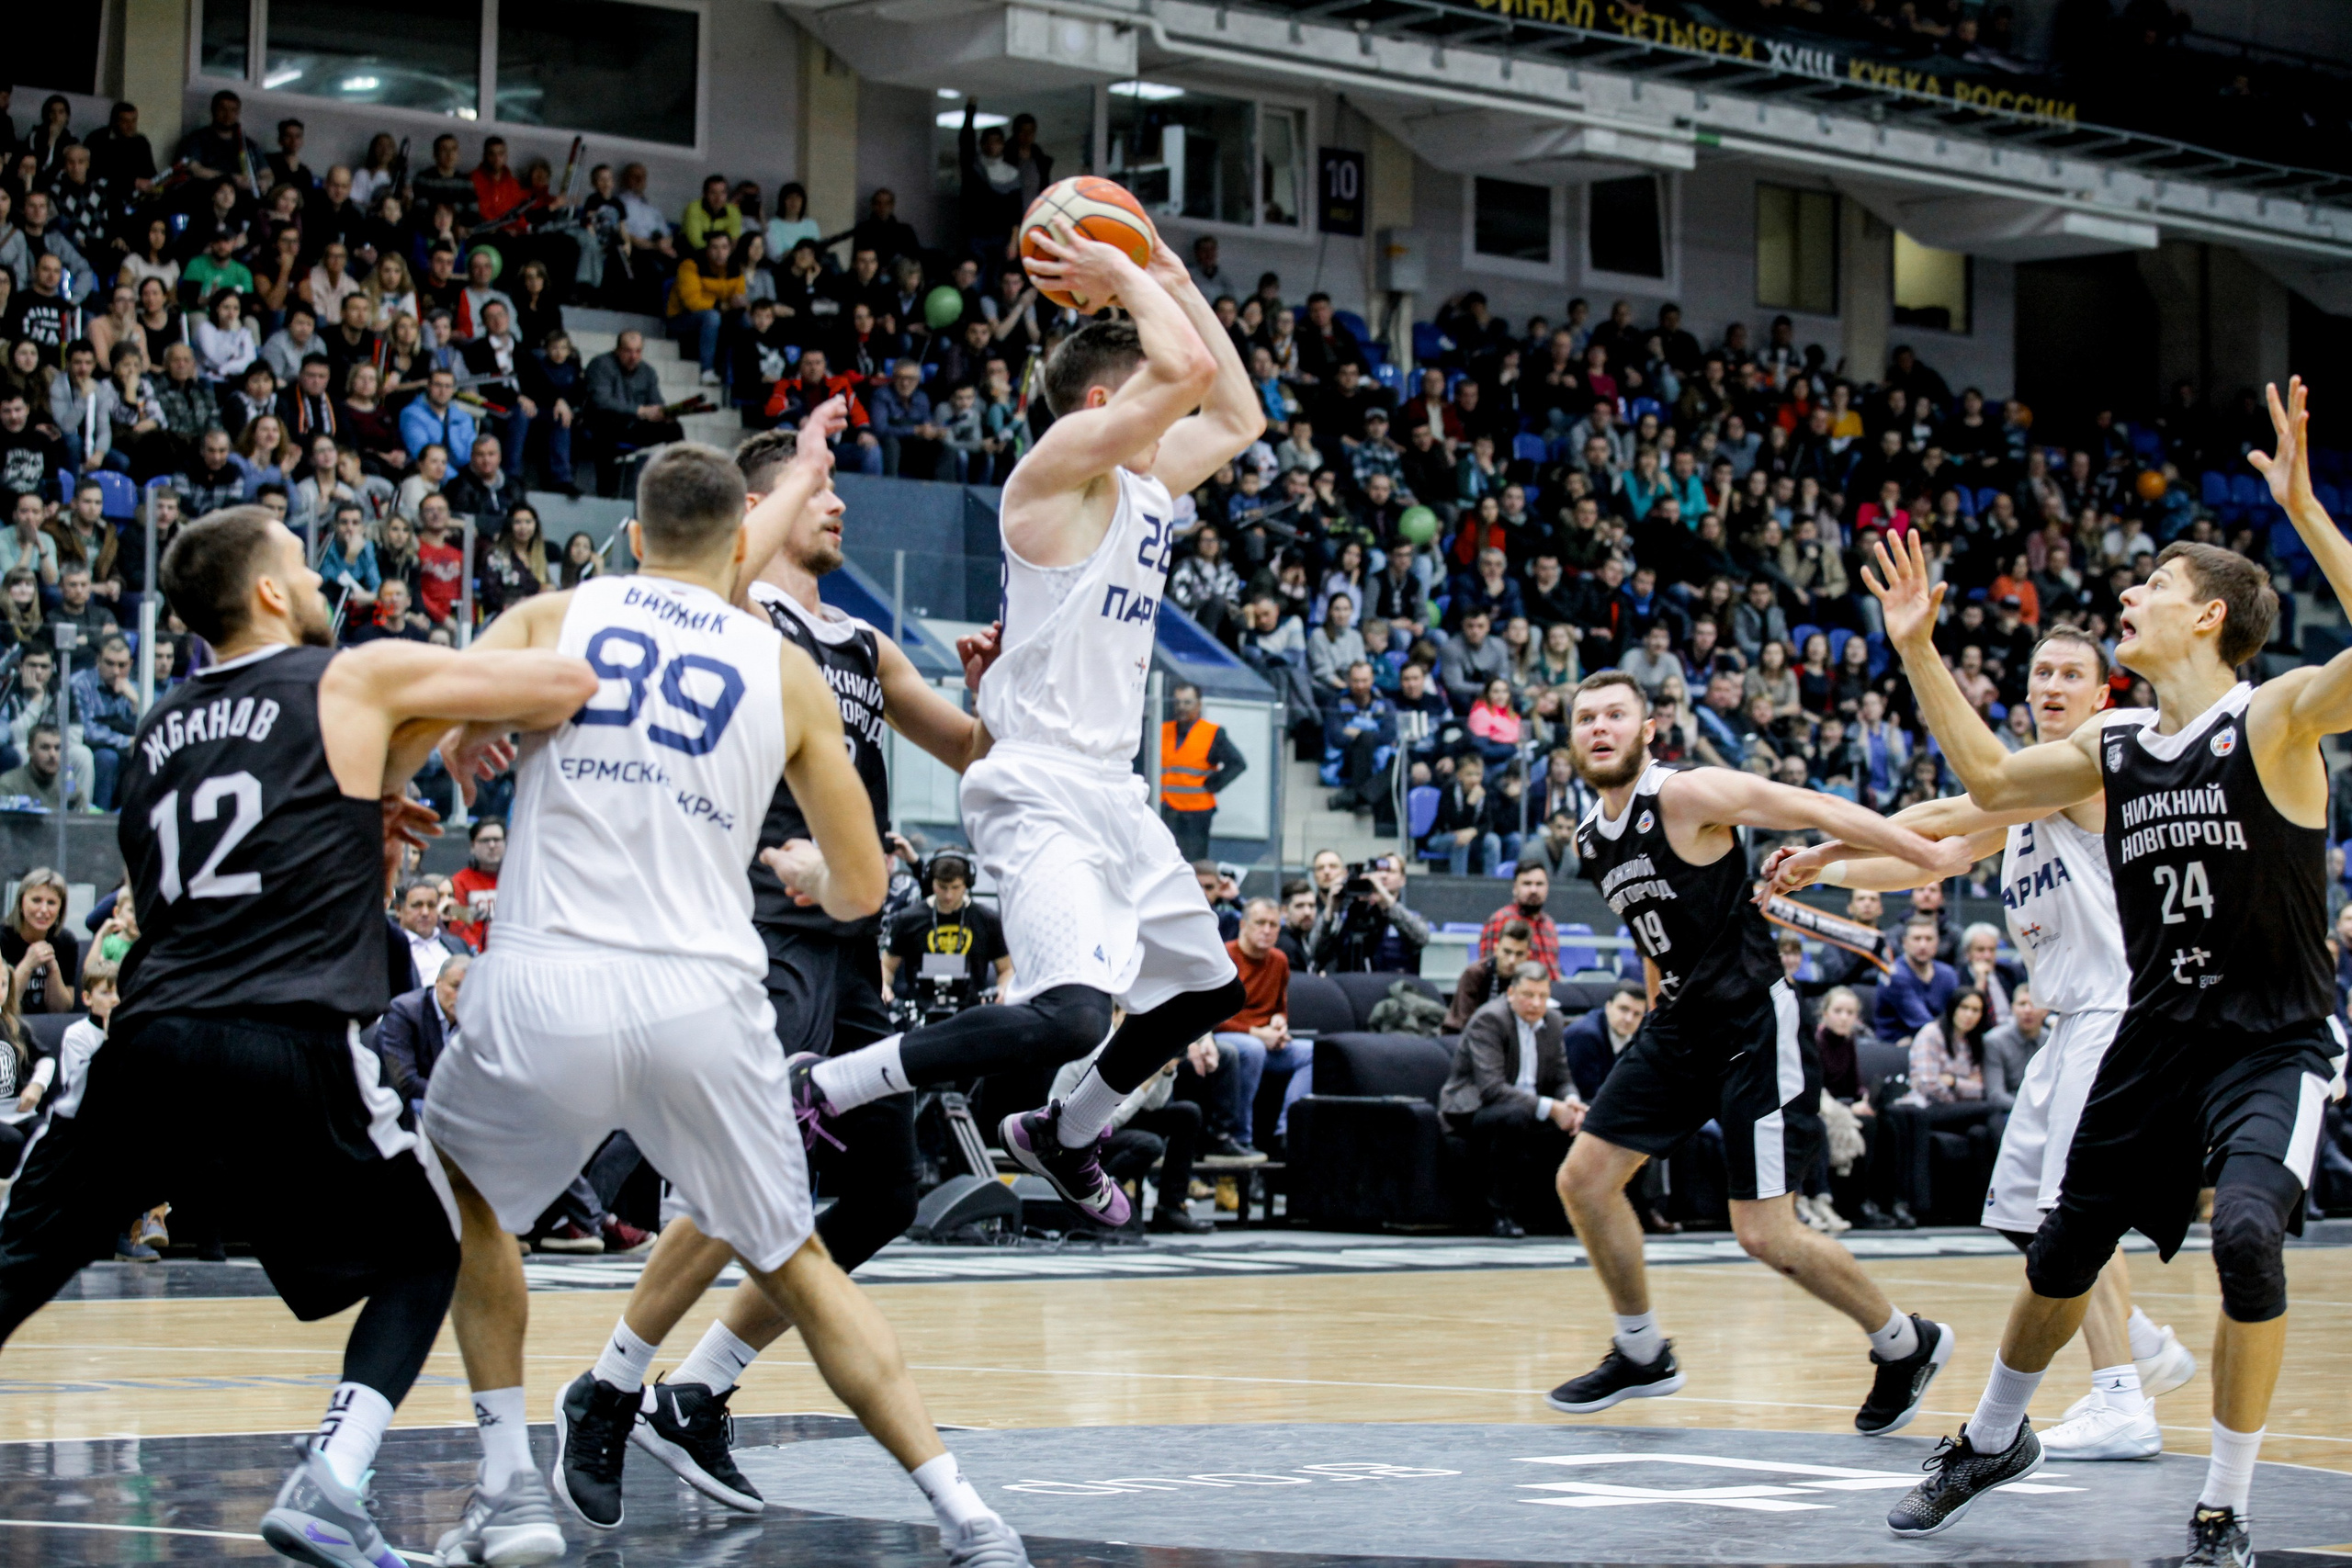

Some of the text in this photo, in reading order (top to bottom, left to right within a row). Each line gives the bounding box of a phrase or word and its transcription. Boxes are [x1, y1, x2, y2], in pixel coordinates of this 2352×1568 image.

[1954, 80, 2078, 127] РОССИИ
[1326, 159, 1358, 200] 10
[1138, 513, 1174, 575] 28
[1102, 584, 1159, 632] ПАР
[819, 663, 886, 712] ЖНИЙ
[141, 696, 281, 776] ЖБАНОВ
[560, 758, 672, 787] ЕРМСК
[2121, 783, 2228, 829] НИЖНИЙ
[149, 770, 264, 906] 12
[2120, 820, 2248, 864] НОВГОРОД
[2000, 857, 2072, 909] АРМА
[2153, 860, 2215, 925] 24
[1632, 909, 1672, 957] 19
